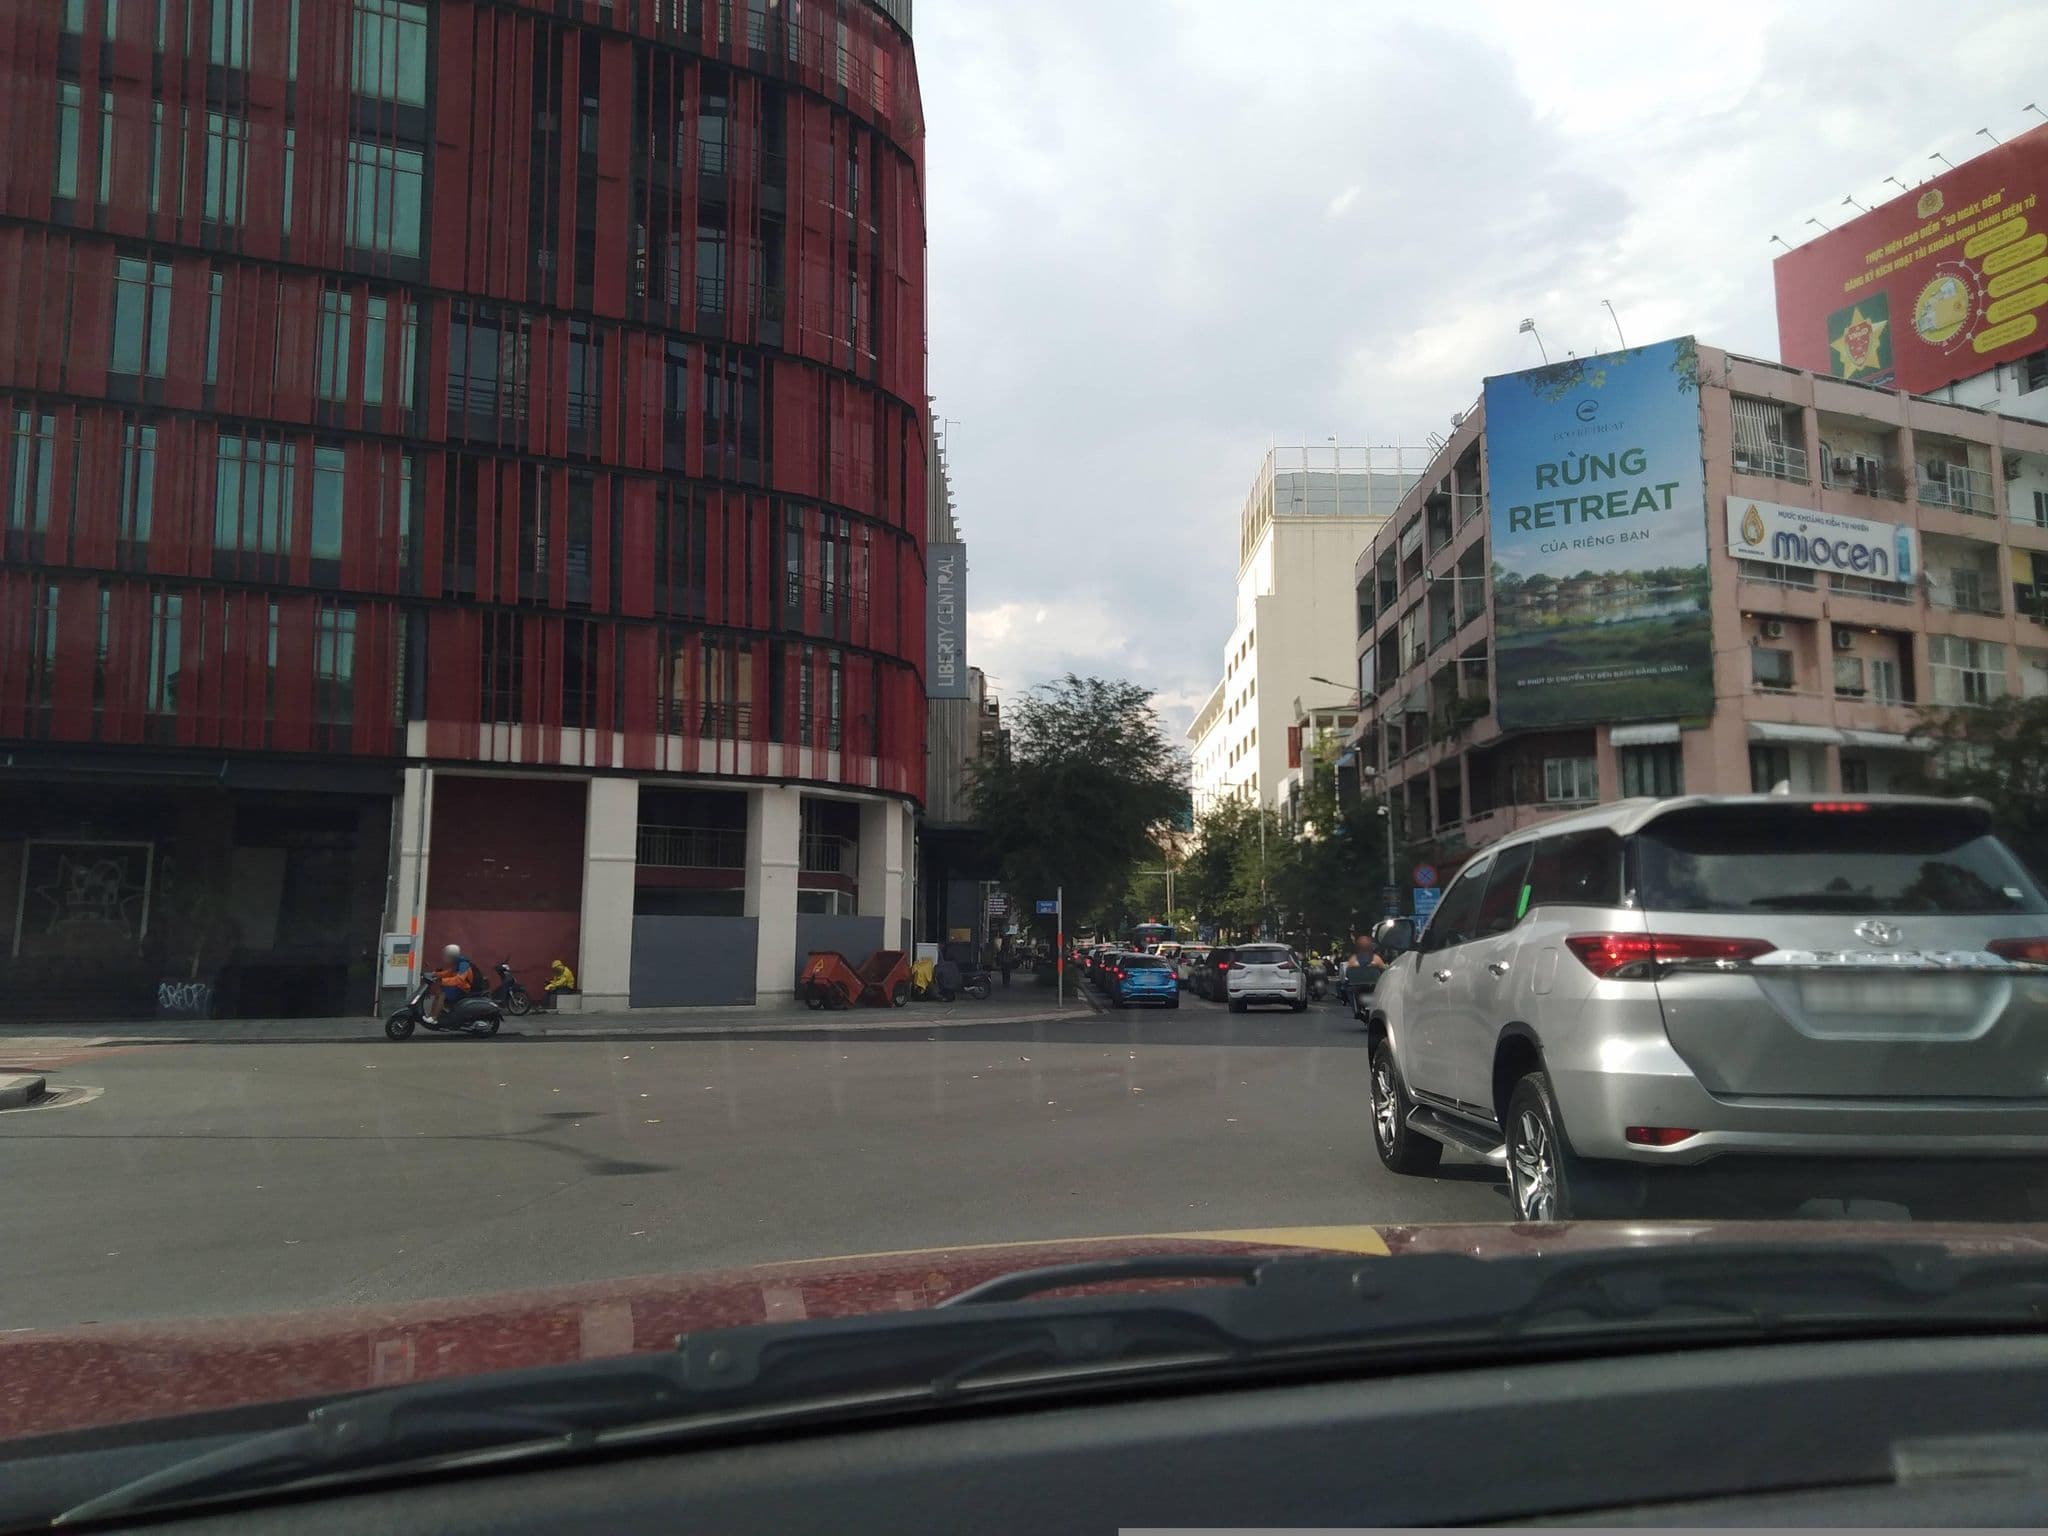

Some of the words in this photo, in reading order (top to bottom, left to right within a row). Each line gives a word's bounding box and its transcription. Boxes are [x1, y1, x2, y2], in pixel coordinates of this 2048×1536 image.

[1536, 448, 1647, 490] RỪNG
[1509, 481, 1680, 533] RETREAT
[1541, 539, 1568, 554] CỦA
[1573, 534, 1615, 549] RIÊNG
[1620, 529, 1650, 544] BẠN
[1773, 524, 1888, 576] miocen
[938, 555, 954, 625] CENTRAL
[938, 628, 954, 686] LIBERTY
